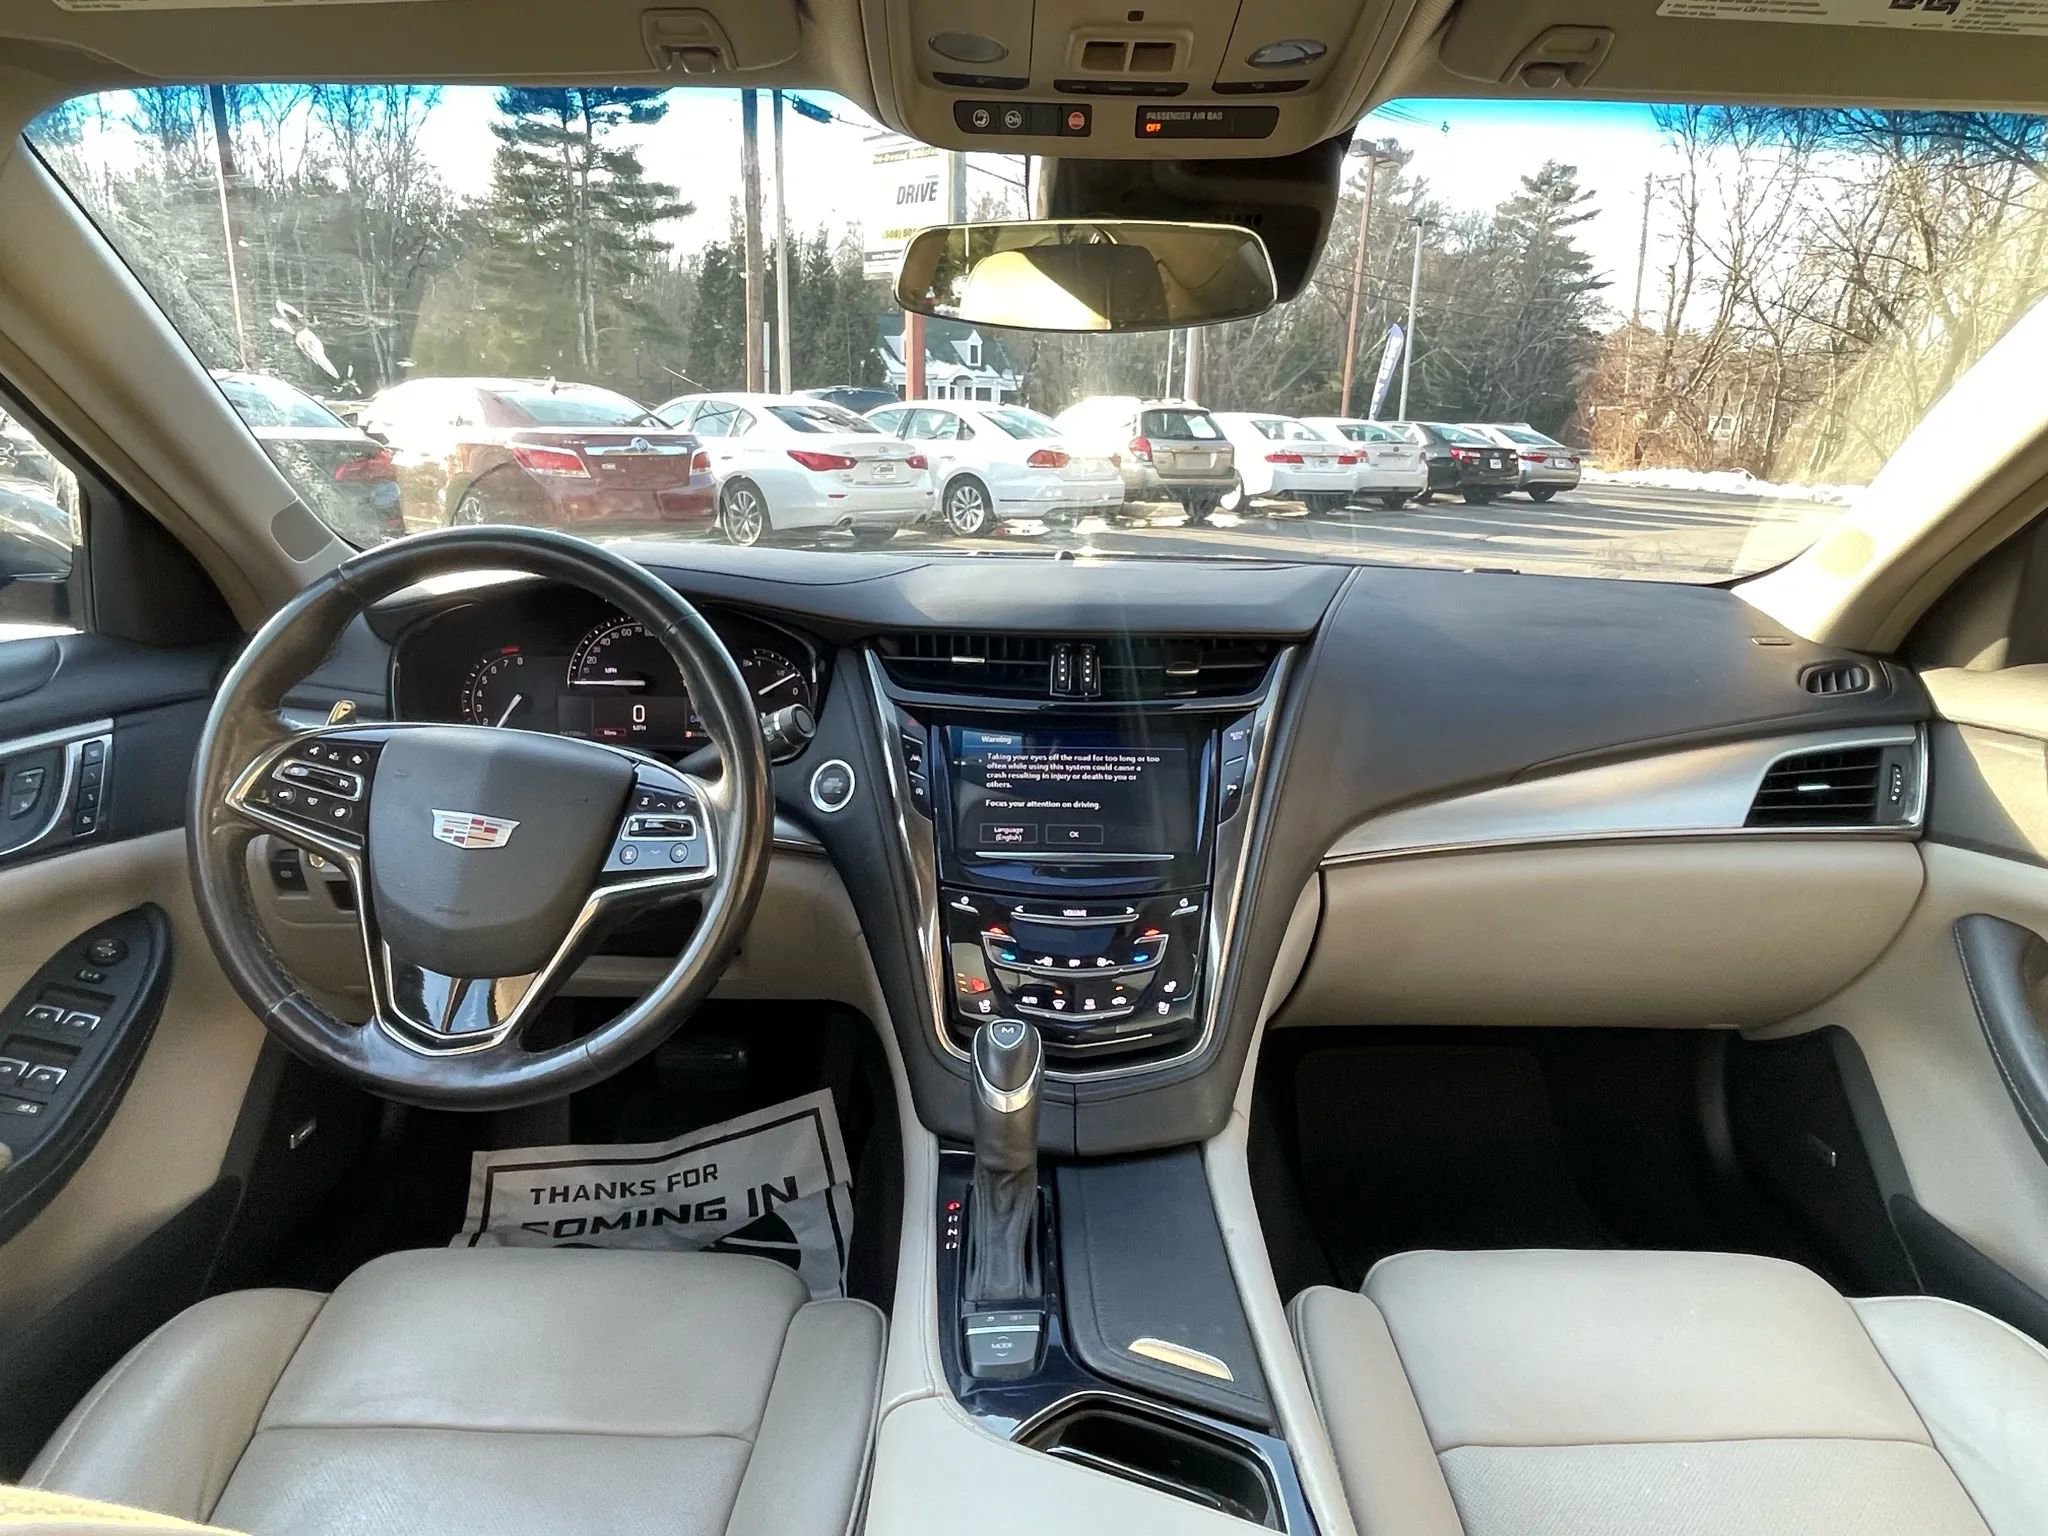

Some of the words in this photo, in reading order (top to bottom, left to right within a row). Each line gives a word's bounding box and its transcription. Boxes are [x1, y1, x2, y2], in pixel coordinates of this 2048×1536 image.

[1146, 112, 1191, 120] PASSENGER
[1192, 112, 1206, 120] AIR
[1207, 112, 1223, 120] BAG
[1146, 123, 1161, 132] OFF
[896, 181, 939, 205] DRIVE
[504, 660, 509, 668] 7
[586, 656, 598, 664] 20
[482, 676, 488, 684] 5
[476, 704, 482, 712] 3
[632, 704, 646, 723] 0
[483, 718, 489, 726] 2
[981, 736, 1012, 744] Warning
[987, 753, 1012, 762] Taking
[1012, 754, 1029, 762] your
[1048, 753, 1059, 761] off
[1092, 754, 1103, 762] for
[1119, 755, 1136, 763] long
[1065, 764, 1091, 772] system
[1092, 763, 1112, 771] could
[1008, 772, 1041, 781] resulting
[1051, 773, 1071, 781] injury
[1073, 801, 1102, 810] driving.
[993, 827, 1024, 835] Language
[995, 834, 1022, 842] (English)
[530, 1179, 656, 1206] THANKS
[667, 1163, 718, 1193] FOR
[747, 1176, 799, 1218] IN
